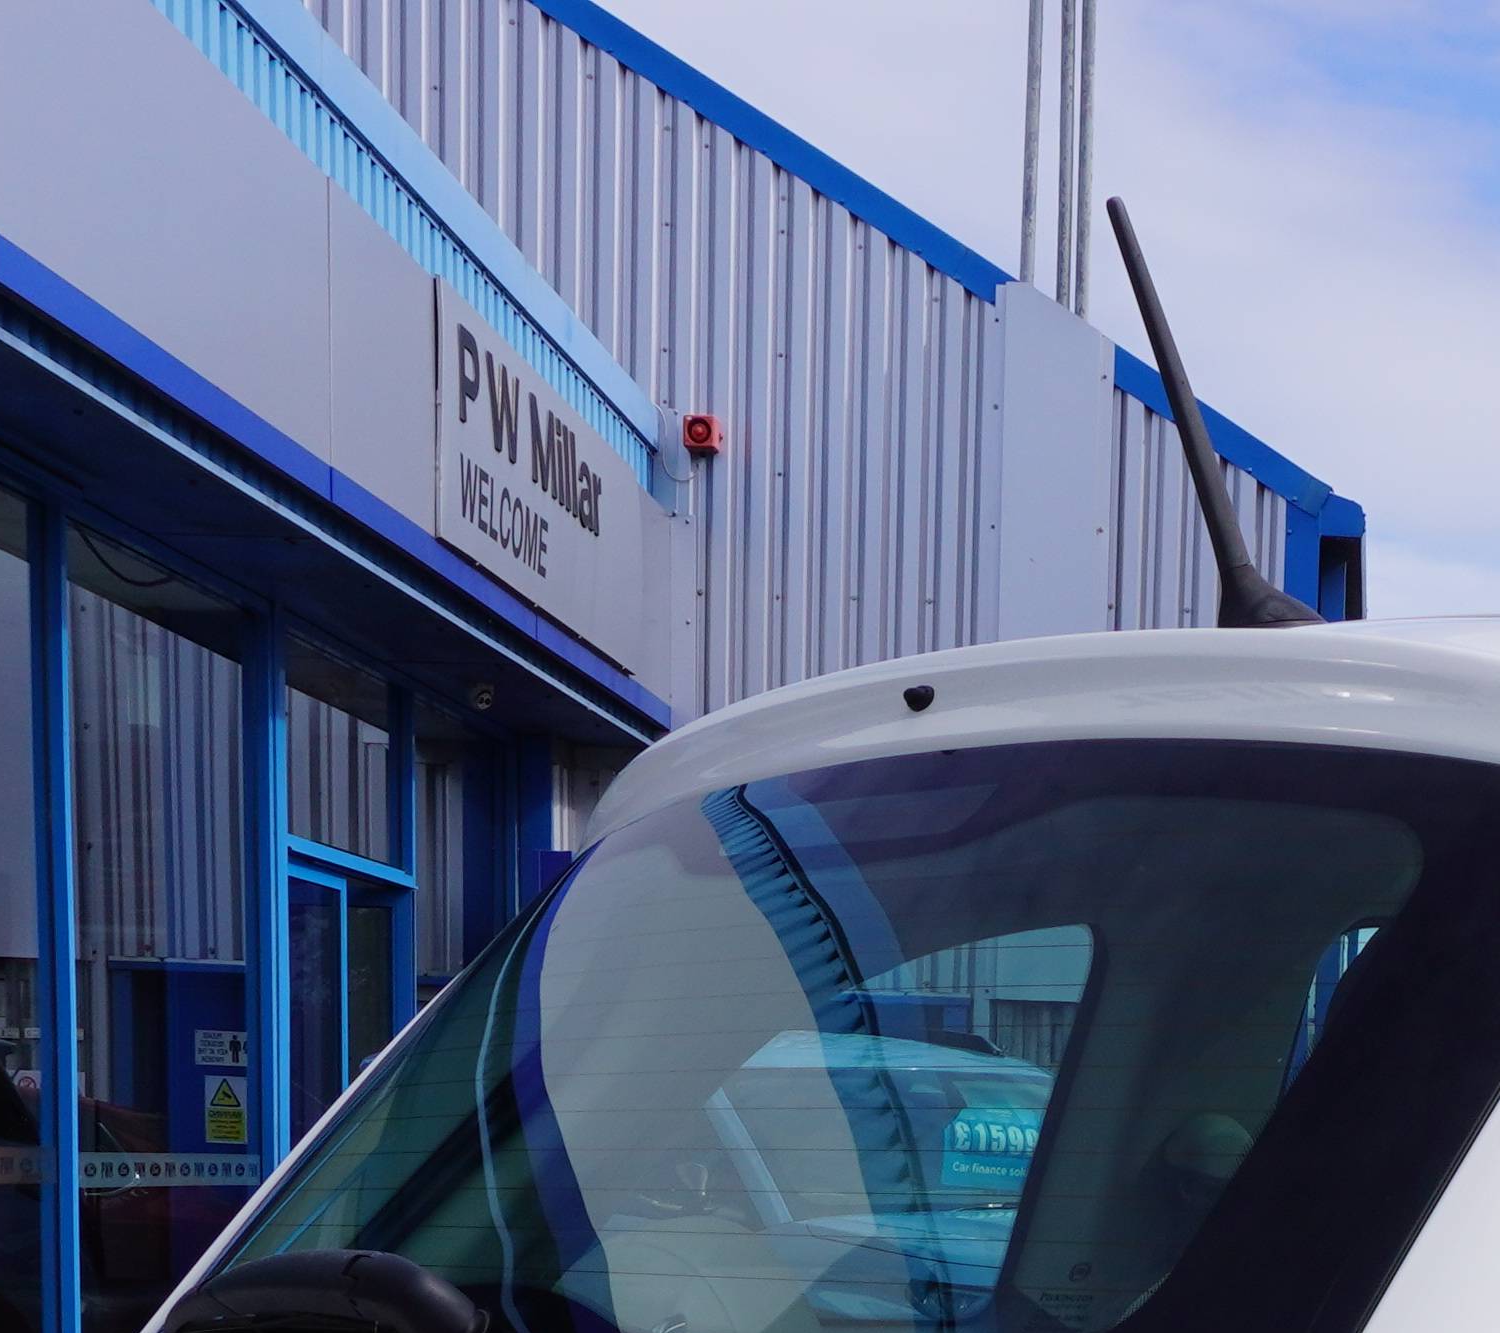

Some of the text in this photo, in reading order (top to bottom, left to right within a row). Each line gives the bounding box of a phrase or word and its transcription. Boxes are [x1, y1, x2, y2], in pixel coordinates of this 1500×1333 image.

[457, 323, 602, 537] P W Millar
[460, 452, 548, 578] WELCOME
